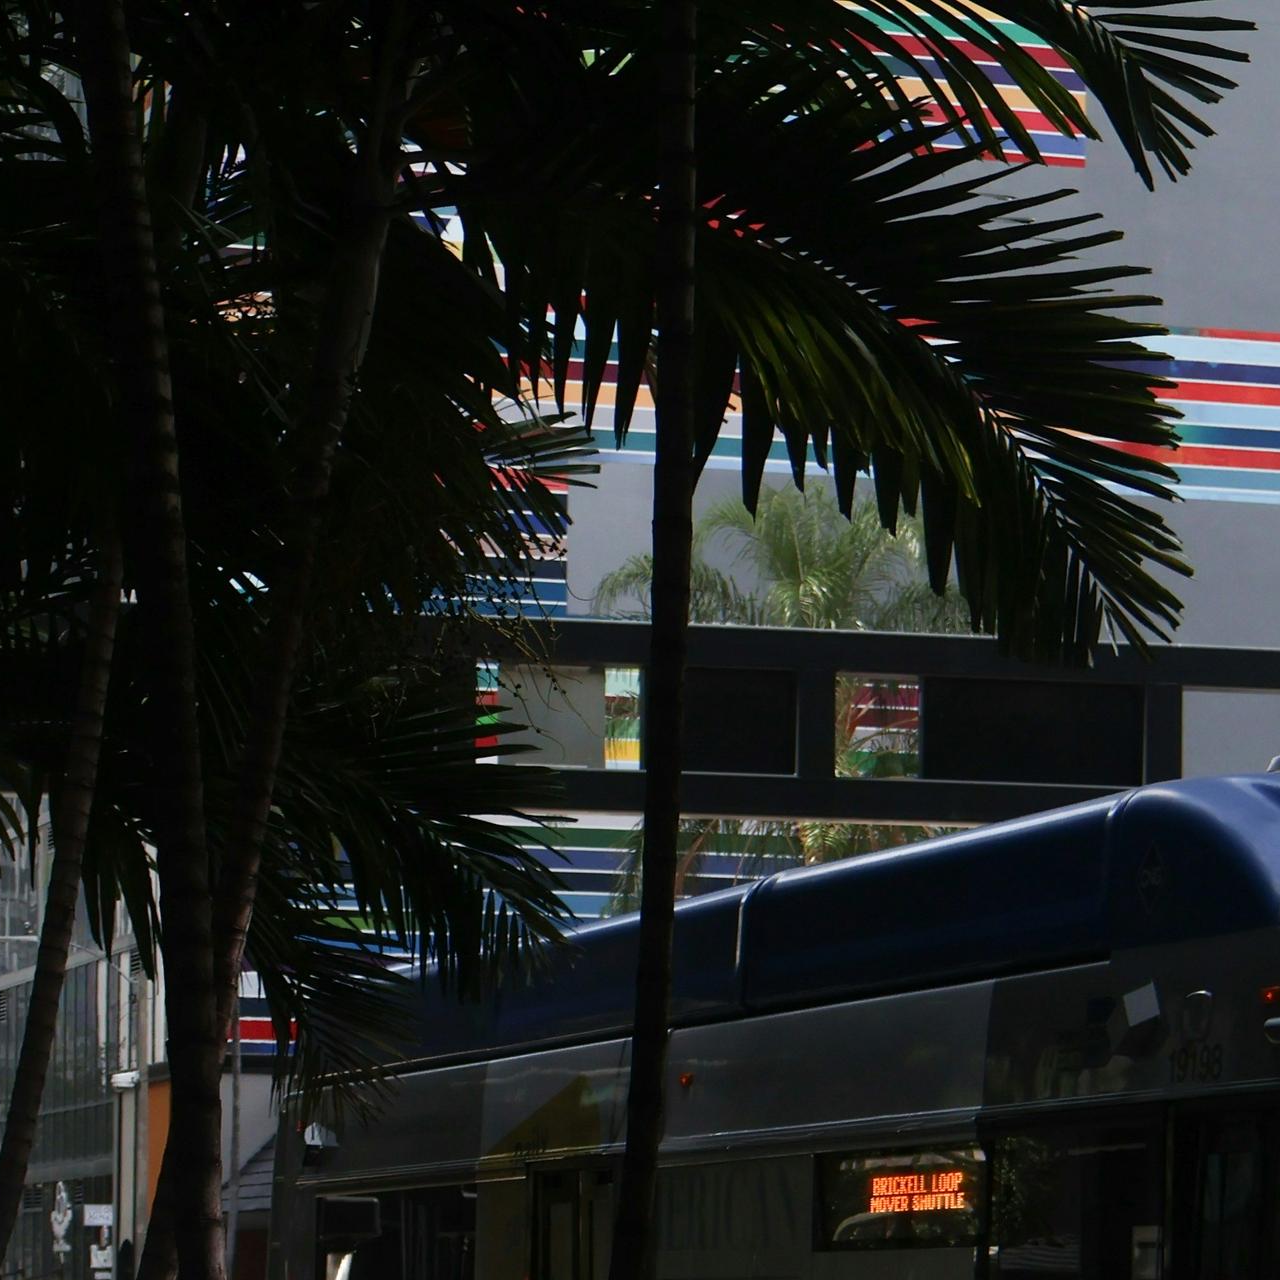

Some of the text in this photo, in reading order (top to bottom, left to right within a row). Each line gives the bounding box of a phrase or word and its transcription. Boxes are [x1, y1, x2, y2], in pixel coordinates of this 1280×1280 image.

[1169, 1044, 1223, 1083] 19198
[871, 1171, 963, 1196] BRICKELL LOOP
[869, 1191, 966, 1214] MOVER SHUTTLE
